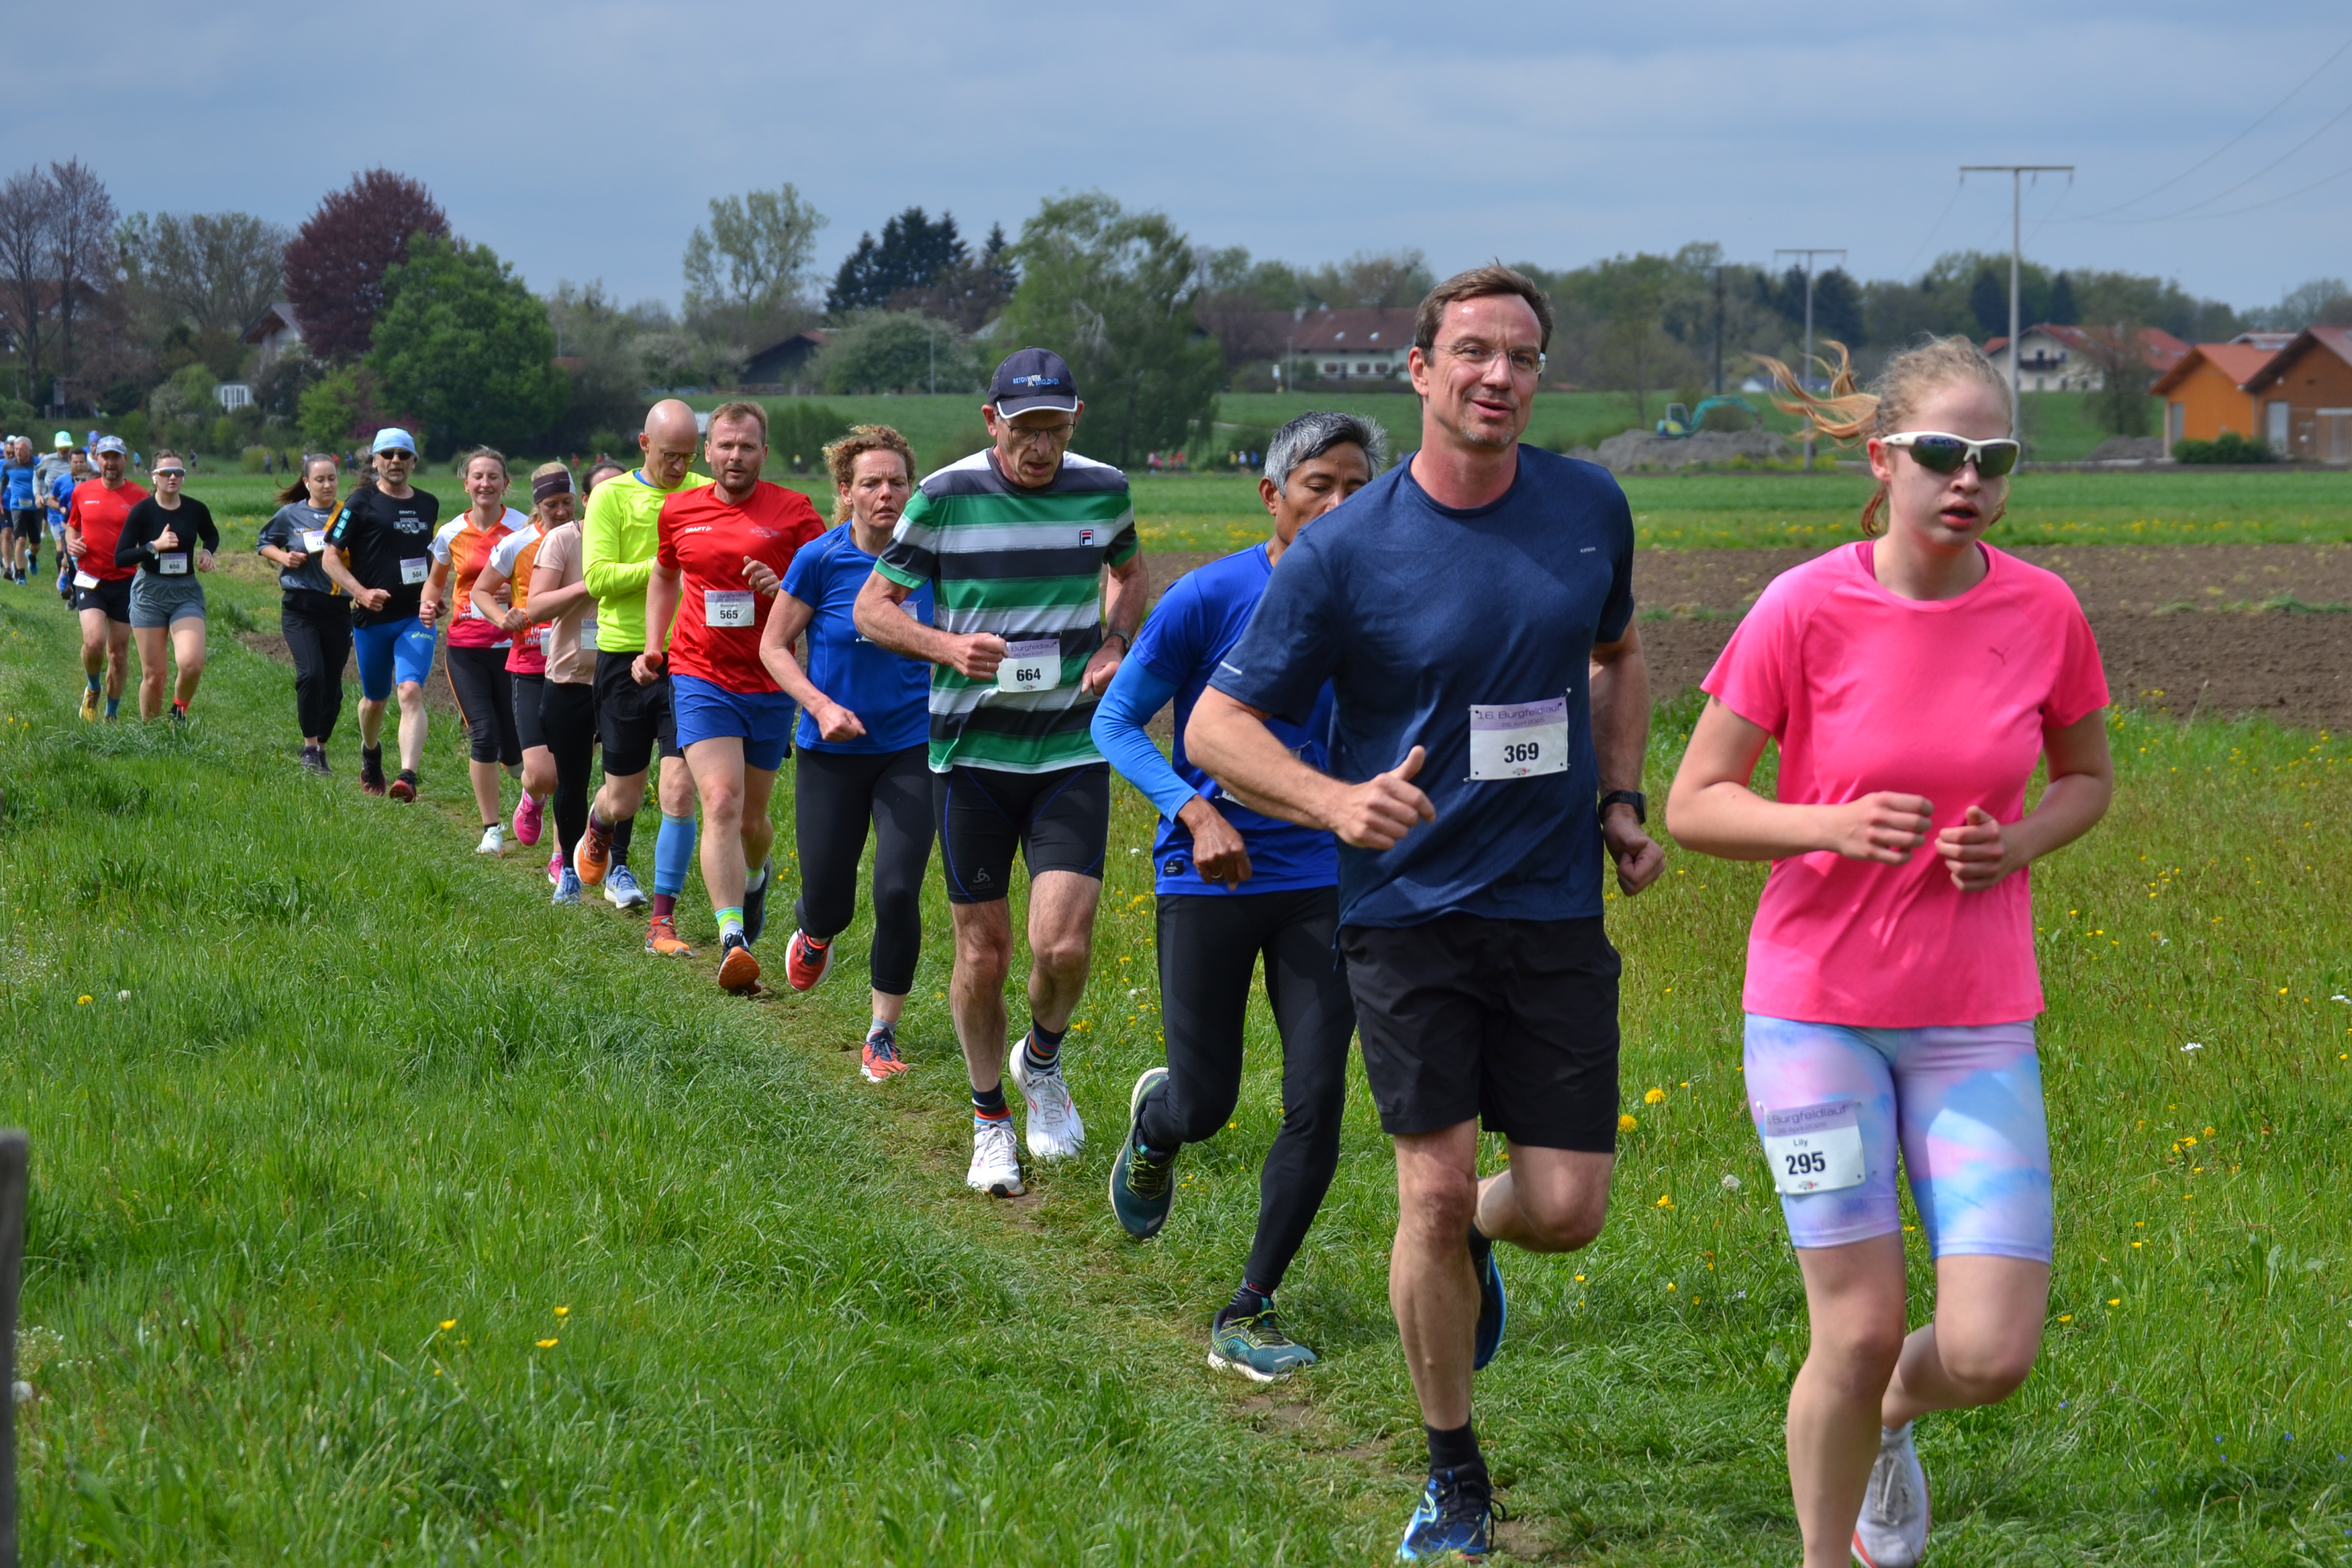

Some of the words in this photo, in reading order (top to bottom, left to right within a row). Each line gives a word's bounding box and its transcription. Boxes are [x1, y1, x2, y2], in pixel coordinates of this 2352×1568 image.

[720, 610, 738, 619] 565
[1011, 642, 1055, 651] Burgfeldlauf
[1016, 668, 1041, 681] 664
[1499, 704, 1560, 719] Burgfeldlauf
[1504, 742, 1539, 763] 369
[1772, 1105, 1846, 1124] Burgfeldlauf
[1793, 1138, 1808, 1147] Lily
[1786, 1150, 1826, 1175] 295
